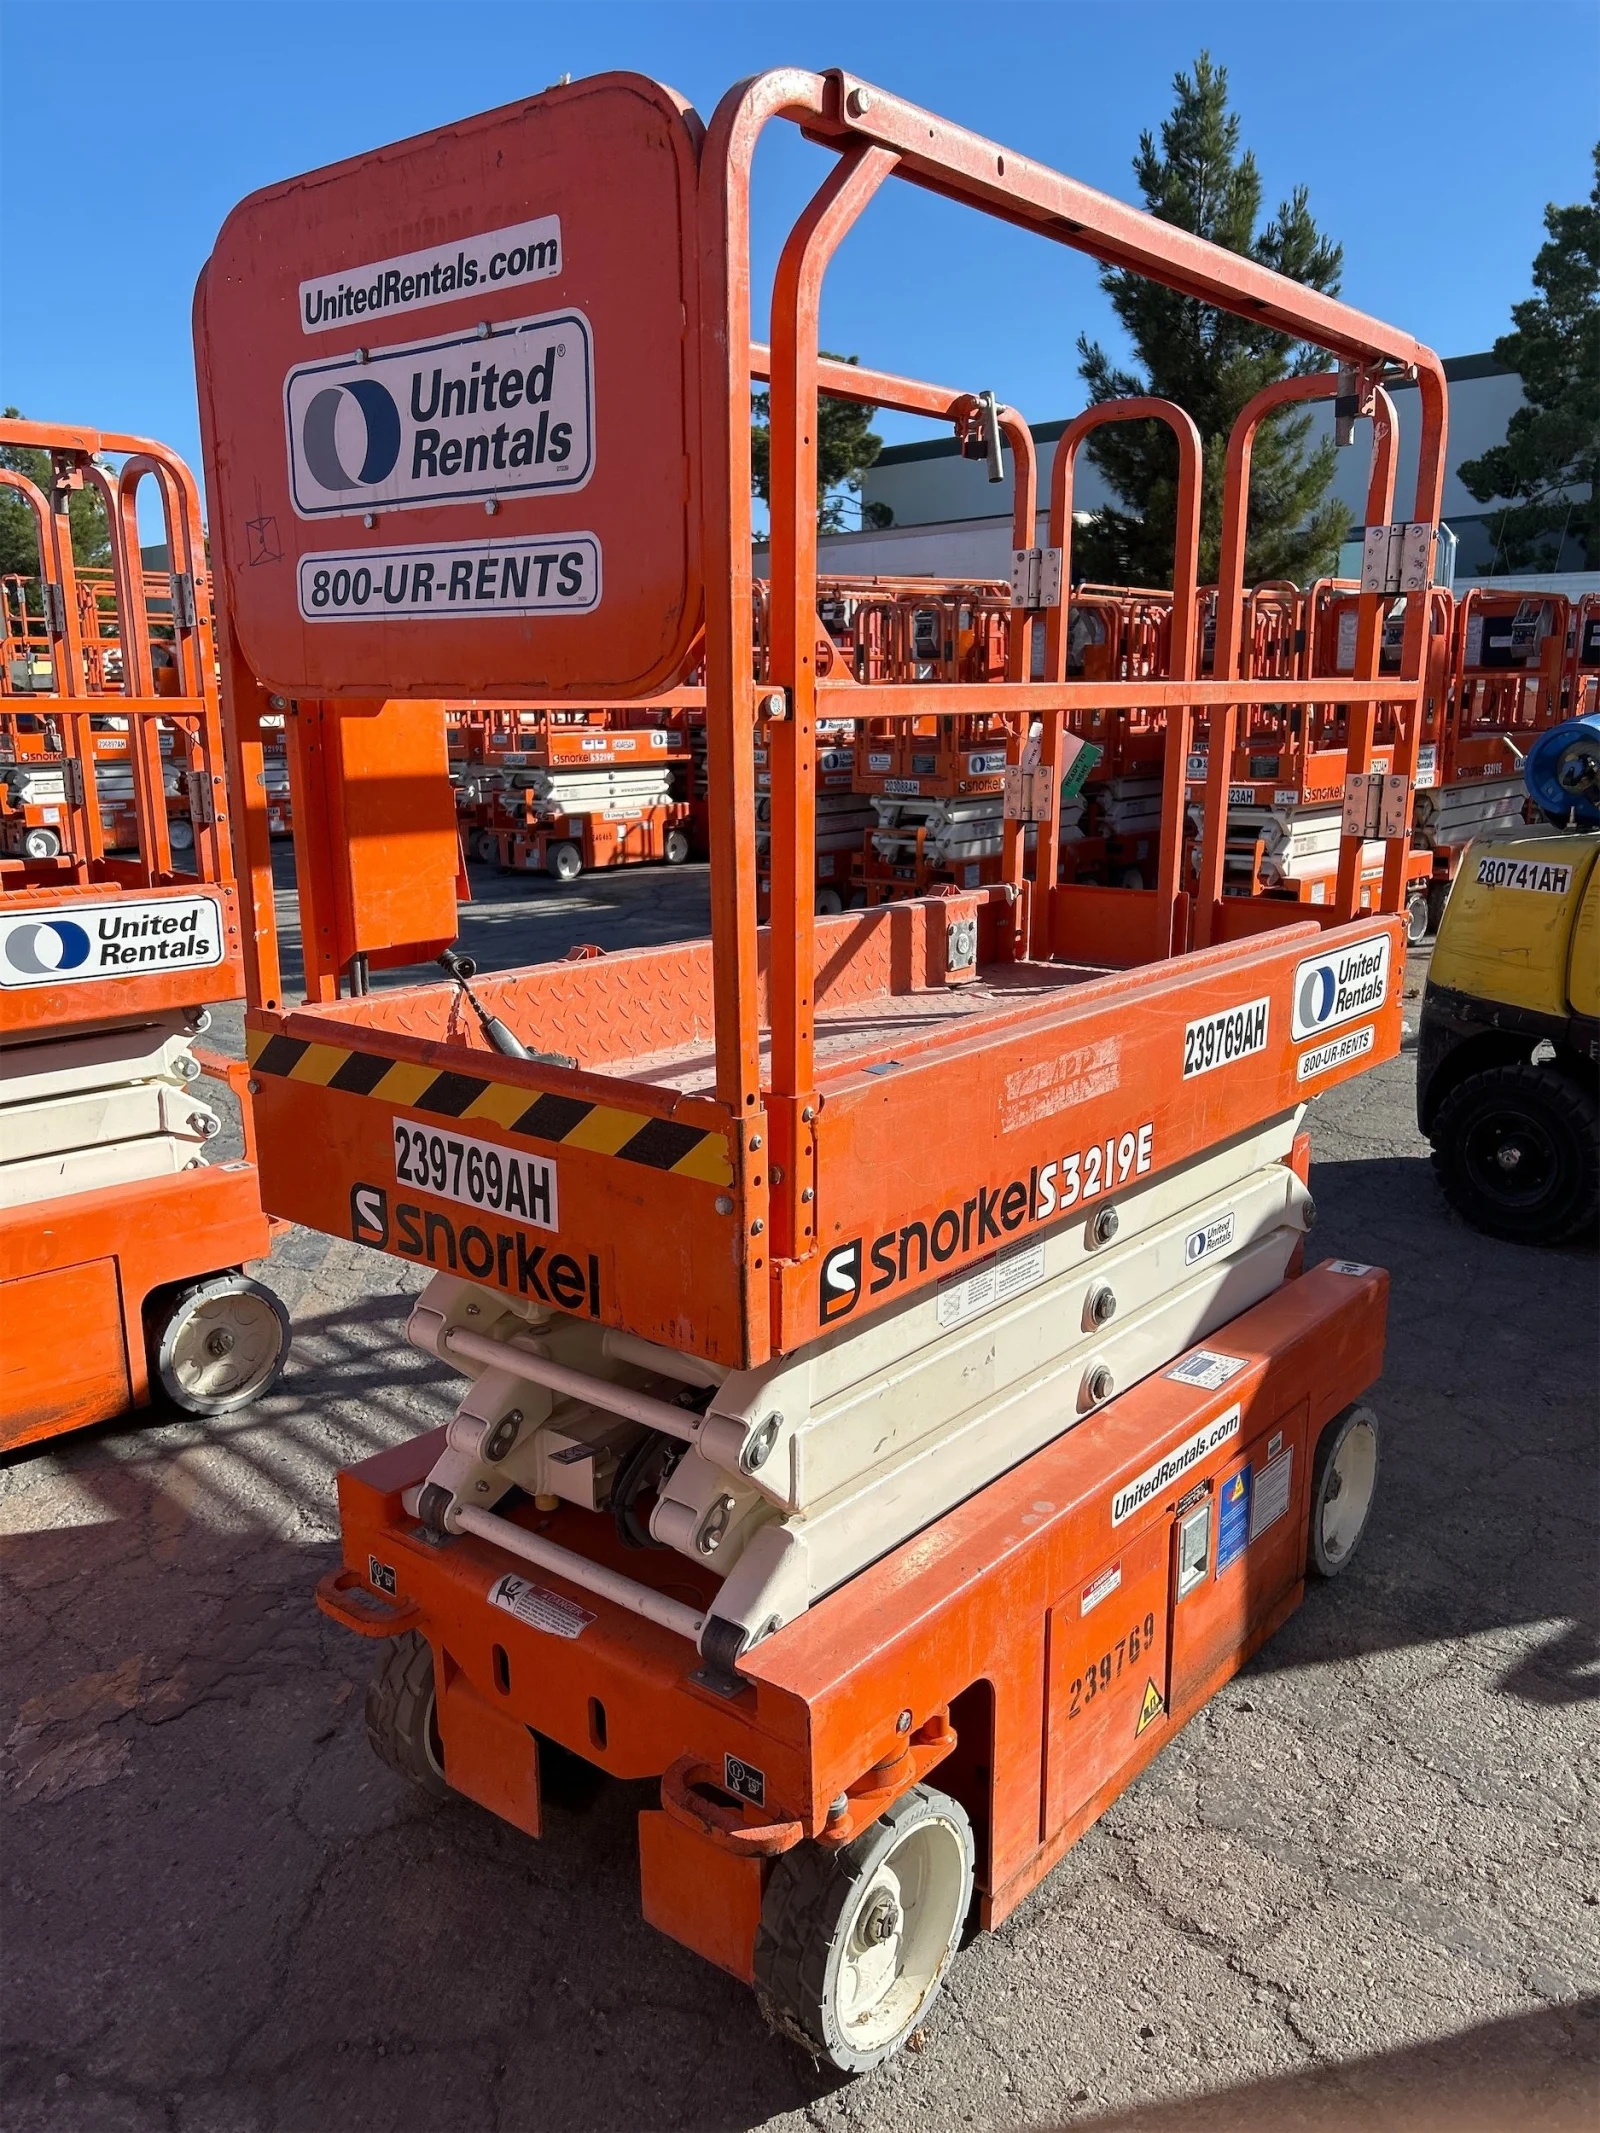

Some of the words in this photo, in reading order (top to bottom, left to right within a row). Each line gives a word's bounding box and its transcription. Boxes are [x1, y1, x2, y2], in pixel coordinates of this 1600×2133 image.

[305, 238, 558, 325] UnitedRentals.com
[411, 347, 556, 422] United
[411, 411, 573, 479] Rentals
[311, 551, 584, 607] 800-UR-RENTS
[1477, 860, 1569, 892] 280741AH
[98, 909, 199, 940] United
[99, 934, 210, 966] Rentals
[1338, 946, 1384, 985] United
[1335, 974, 1384, 1014] Rentals
[1184, 1004, 1267, 1076] 239769AH
[1303, 1031, 1370, 1074] 800-UR-RENTS
[395, 1125, 551, 1225] 239769AH
[870, 1165, 1037, 1296] snorkel
[1036, 1121, 1154, 1221] S3219E
[1207, 1218, 1231, 1239] United
[395, 1203, 600, 1319] snorkel
[1207, 1230, 1231, 1250] Rentals
[1114, 1414, 1239, 1520] UnitedRentals.com
[1093, 1567, 1114, 1589] DANGER
[546, 1593, 584, 1617] DANGER
[1068, 1612, 1155, 1720] 239769
